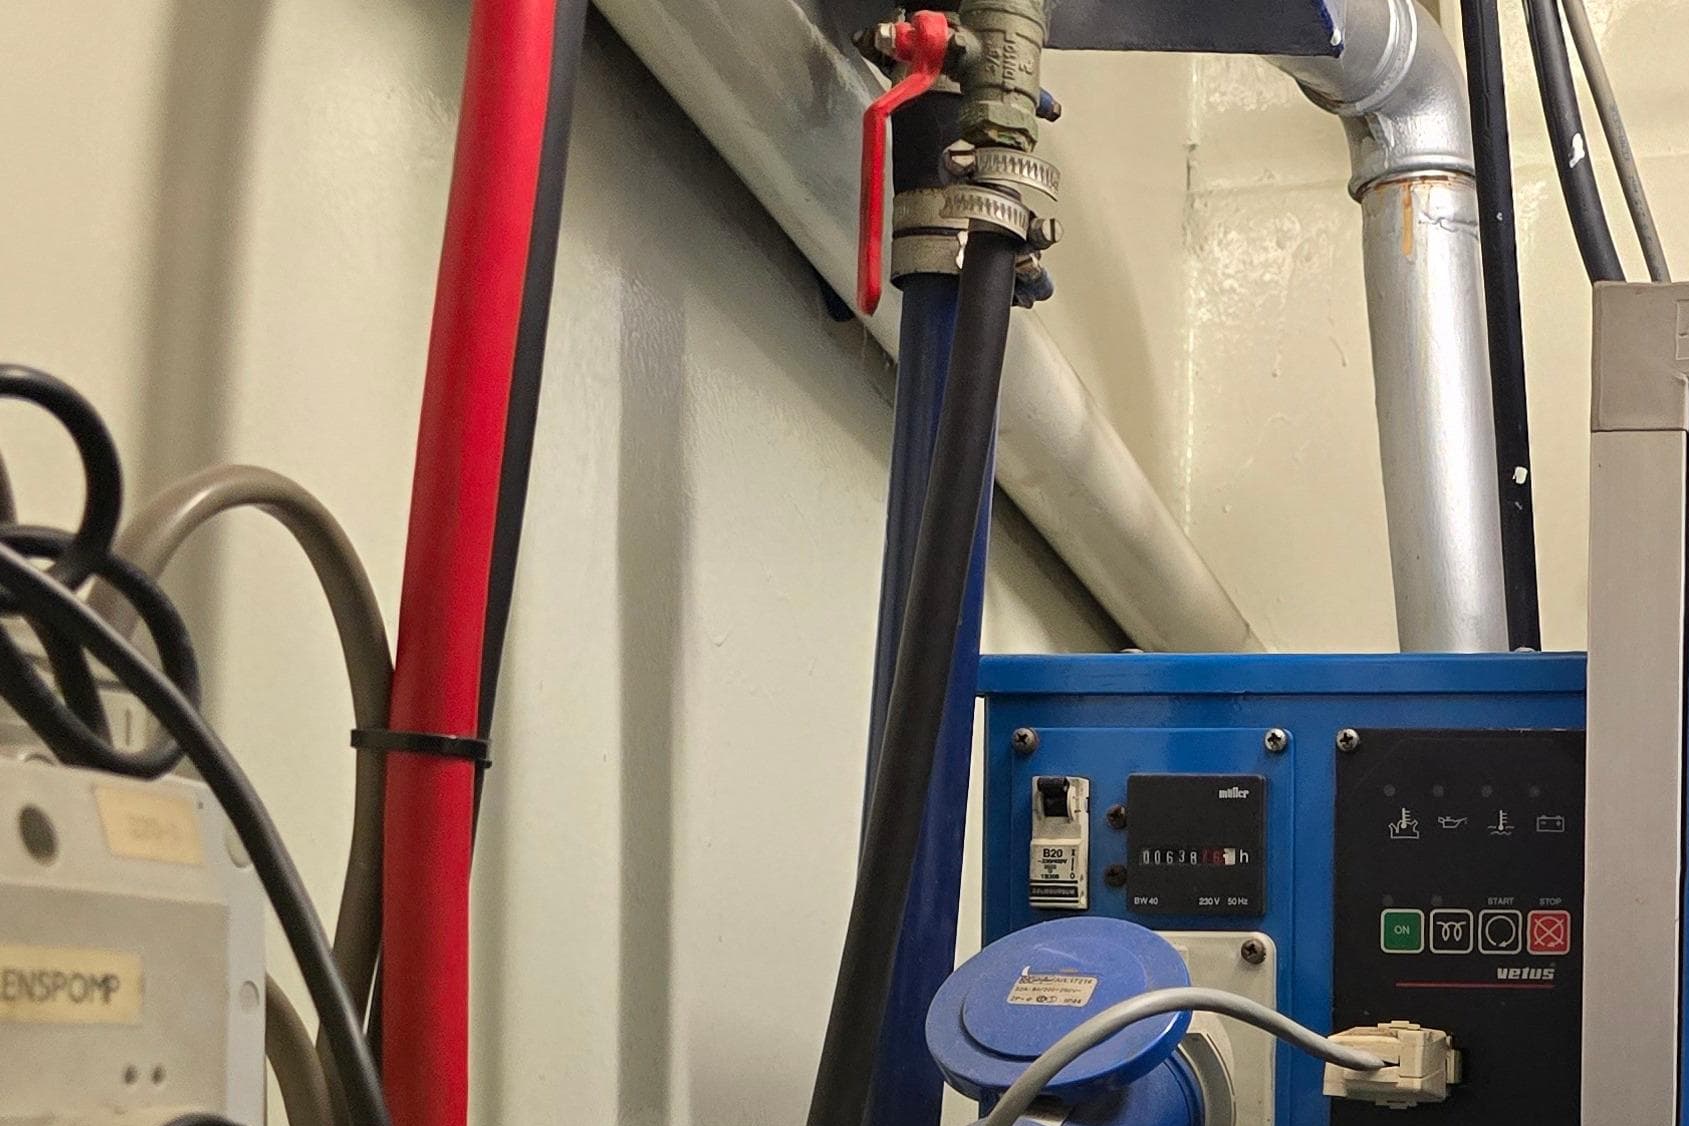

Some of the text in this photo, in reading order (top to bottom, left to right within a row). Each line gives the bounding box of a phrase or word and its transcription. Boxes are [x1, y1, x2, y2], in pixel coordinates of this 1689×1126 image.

[1042, 848, 1064, 858] B20
[1487, 897, 1514, 905] START
[1539, 898, 1562, 906] STOP
[1393, 924, 1410, 935] ON
[1496, 966, 1555, 980] vetus
[0, 966, 121, 1005] ENSPOMP
